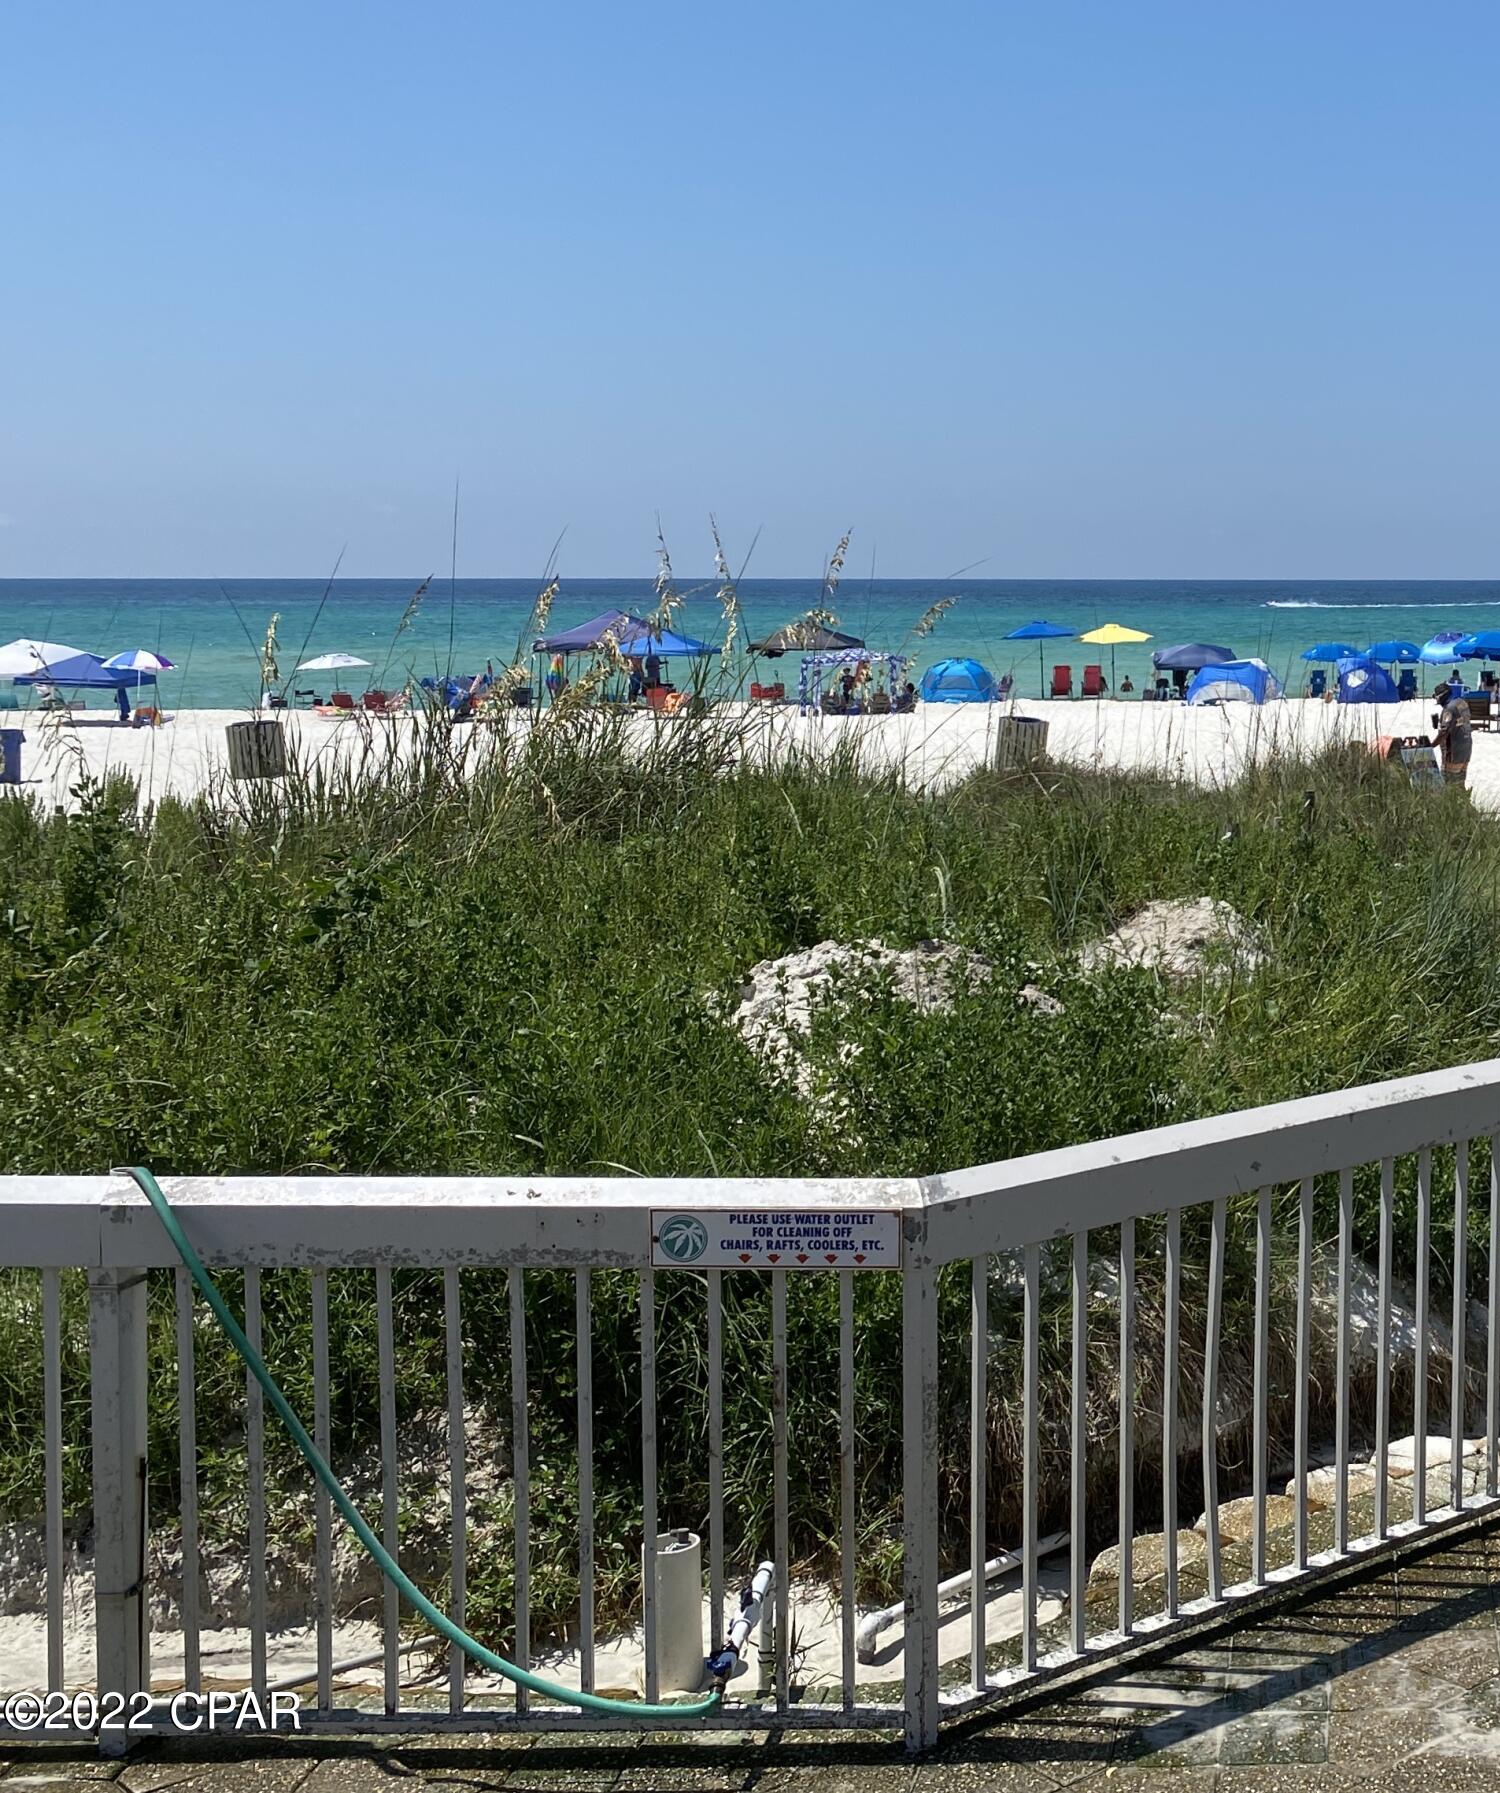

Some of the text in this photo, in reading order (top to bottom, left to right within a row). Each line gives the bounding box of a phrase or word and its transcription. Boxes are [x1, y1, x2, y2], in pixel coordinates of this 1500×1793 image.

[729, 1214, 875, 1225] PLEASE USE WATER OUTLET
[752, 1227, 853, 1238] FOR CLEANING OFF
[720, 1239, 885, 1252] CHAIRS, RAFTS, COOLERS, ETC.
